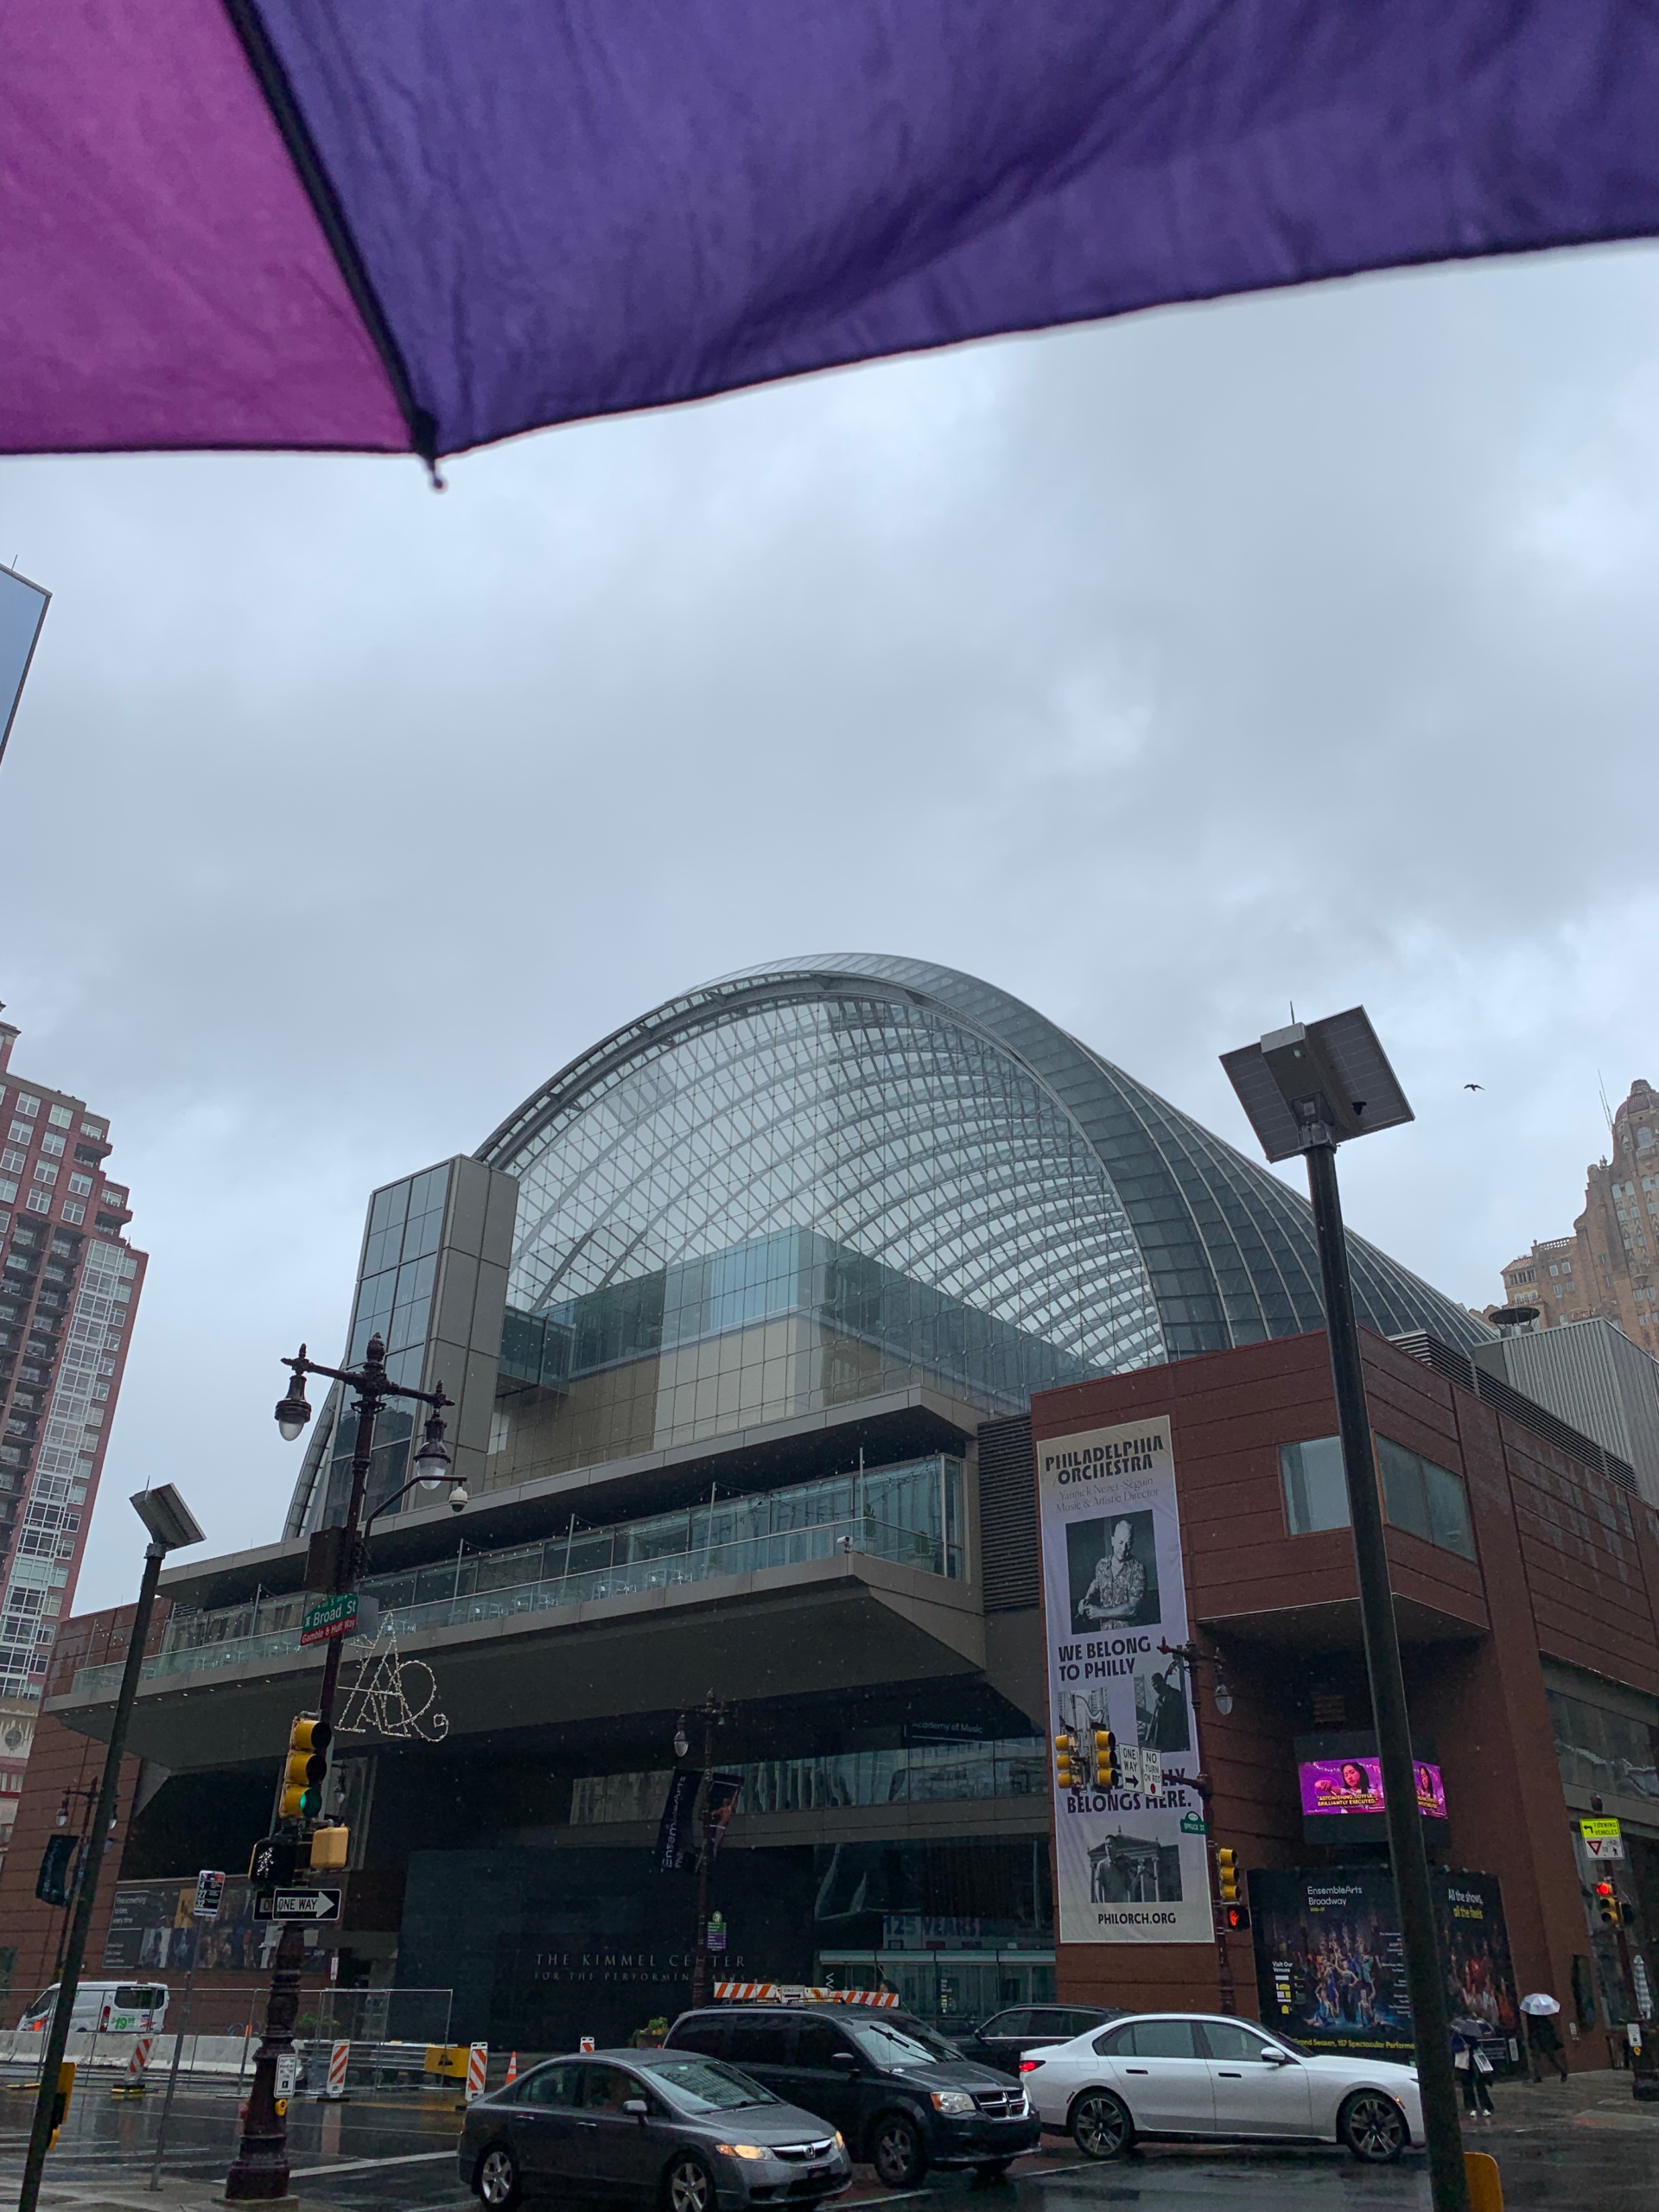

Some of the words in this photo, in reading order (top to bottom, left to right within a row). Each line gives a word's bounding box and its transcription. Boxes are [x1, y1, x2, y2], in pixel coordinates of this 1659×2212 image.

[1046, 1435, 1164, 1471] PHILADELPHIA
[1058, 1454, 1154, 1484] ORCHESTRA
[1059, 1485, 1092, 1500] Yannick
[1056, 1502, 1081, 1514] Music
[1084, 1497, 1091, 1508] &
[1094, 1493, 1122, 1506] Artistic
[1123, 1488, 1159, 1502] Director
[313, 1603, 342, 1627] Broad
[346, 1599, 356, 1614] St
[302, 1630, 323, 1643] Gamble
[325, 1626, 330, 1636] &
[331, 1621, 344, 1634] Huff
[344, 1618, 355, 1630] Way
[1058, 1644, 1082, 1662] WE
[1087, 1636, 1151, 1659] BELONG
[1059, 1664, 1079, 1681] TO
[1084, 1657, 1135, 1679] PHILLY
[912, 1721, 949, 1732] Academy
[961, 1724, 982, 1733] Music
[1122, 1747, 1136, 1760] ONE
[1146, 1752, 1157, 1764] NO
[1123, 1760, 1138, 1772] WAY
[1145, 1764, 1160, 1774] TURN
[1143, 1773, 1151, 1782] ON
[1152, 1774, 1161, 1783] RED
[1067, 1793, 1141, 1813] BELONGS
[1146, 1789, 1192, 1809] HERE.
[200, 1881, 205, 1890] 4
[1306, 1885, 1363, 1895] EnsembleArts
[198, 1890, 207, 1899] 27
[1455, 1889, 1465, 1903] the
[1465, 1891, 1484, 1906] shows,
[196, 1899, 205, 1908] 32
[278, 1898, 296, 1910] ONE
[298, 1898, 318, 1910] WAY
[1308, 1897, 1347, 1907] Broadway
[1460, 1905, 1470, 1918] the
[1097, 1912, 1176, 1924] PHILORCH.ORG
[883, 1916, 917, 1936] 125
[922, 1916, 977, 1937] YEARS
[537, 1954, 569, 1966] THE
[582, 1955, 656, 1967] KIMMEL
[670, 1955, 745, 1967] CETER
[535, 1972, 559, 1981] FOR
[605, 1972, 689, 1981] PERFORMIN
[1313, 2038, 1337, 2048] Season,
[1348, 2039, 1384, 2049] Spectacular
